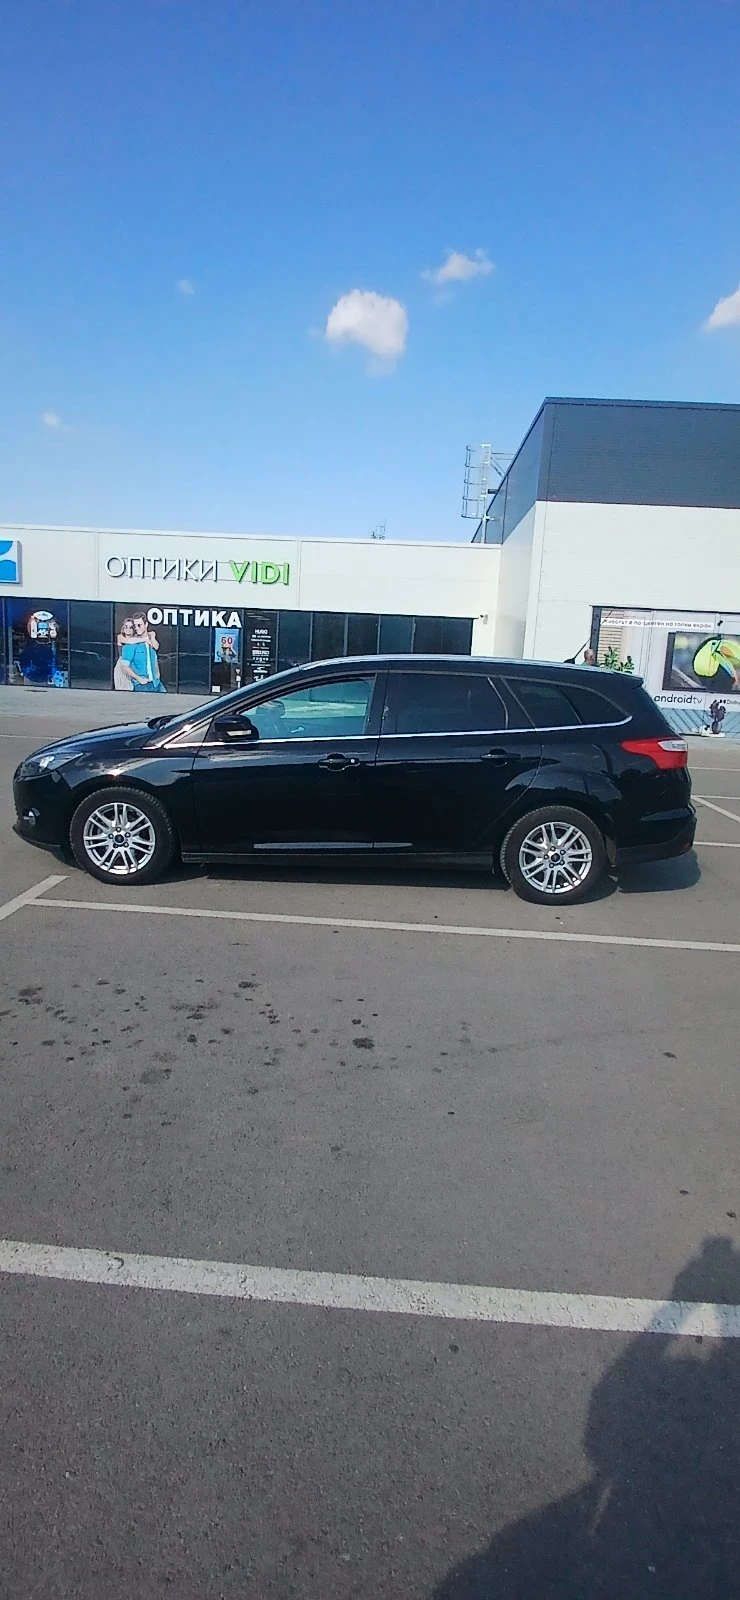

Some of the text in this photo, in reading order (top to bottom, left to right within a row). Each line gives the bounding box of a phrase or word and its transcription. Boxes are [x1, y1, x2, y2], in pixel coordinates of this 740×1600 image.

[106, 556, 290, 586] ОПТИКИ VIDI
[147, 607, 242, 628] ОПТИКА
